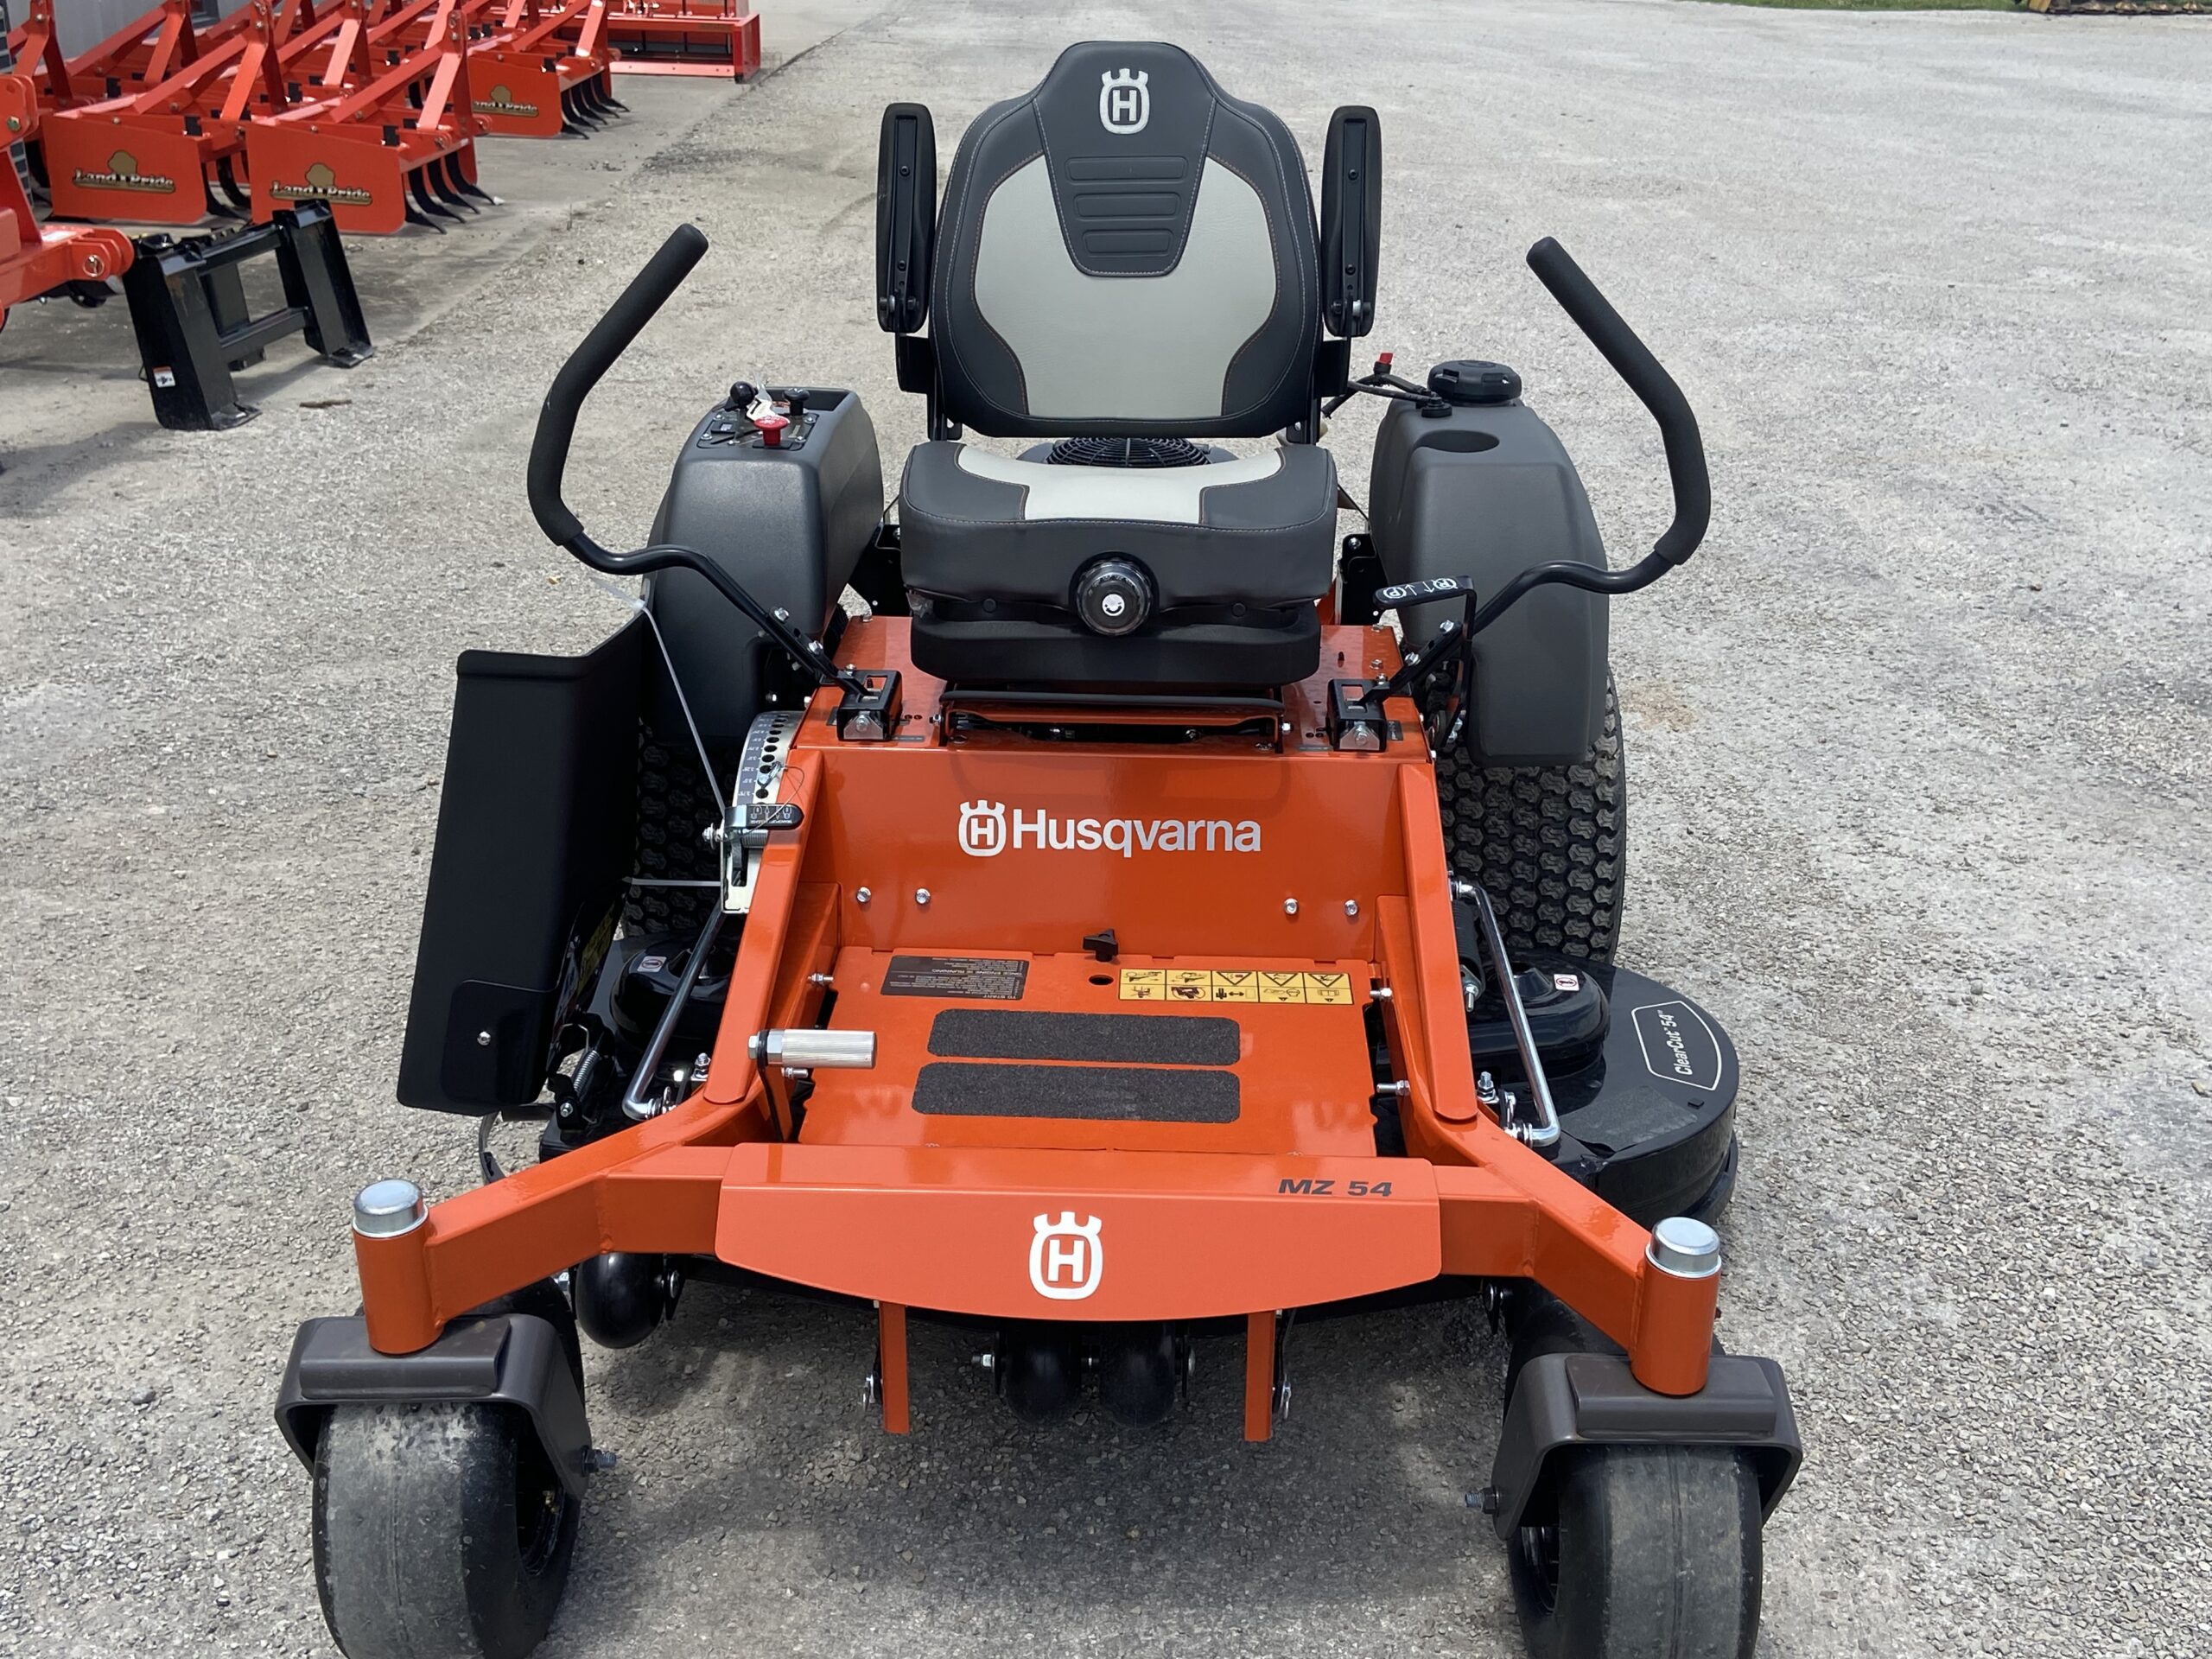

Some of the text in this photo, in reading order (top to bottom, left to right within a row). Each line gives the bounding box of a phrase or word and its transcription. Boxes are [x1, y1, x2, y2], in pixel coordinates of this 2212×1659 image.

[73, 168, 175, 186] Land Pride
[270, 181, 371, 198] Land Pride
[1013, 809, 1262, 858] Husqvarna
[1278, 1179, 1393, 1197] MZ 54
